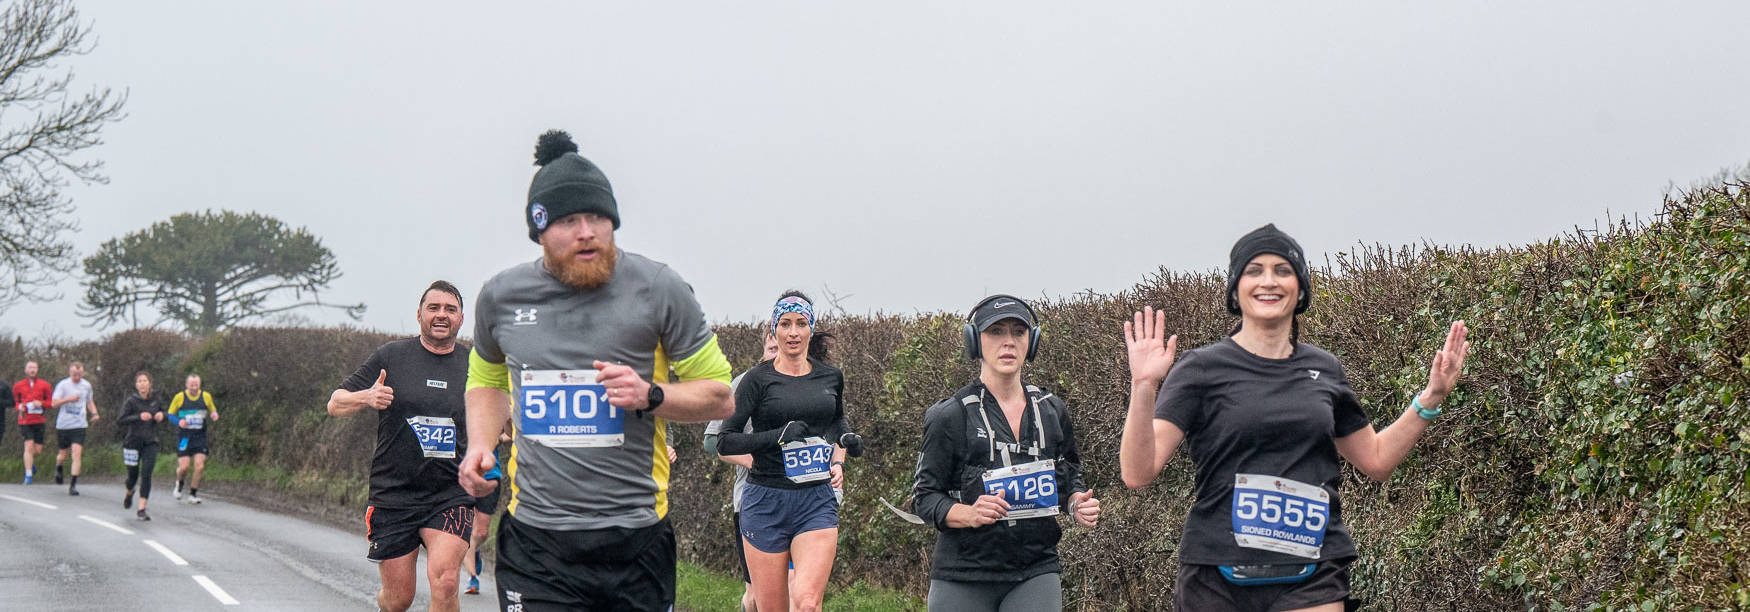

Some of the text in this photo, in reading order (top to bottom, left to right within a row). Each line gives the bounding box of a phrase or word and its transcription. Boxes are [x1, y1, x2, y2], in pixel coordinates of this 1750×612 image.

[558, 426, 597, 434] ROBERTS
[784, 447, 832, 468] 5343
[1236, 493, 1326, 531] 5555
[1241, 525, 1272, 537] SIONED
[1273, 530, 1316, 545] ROWLANDS
